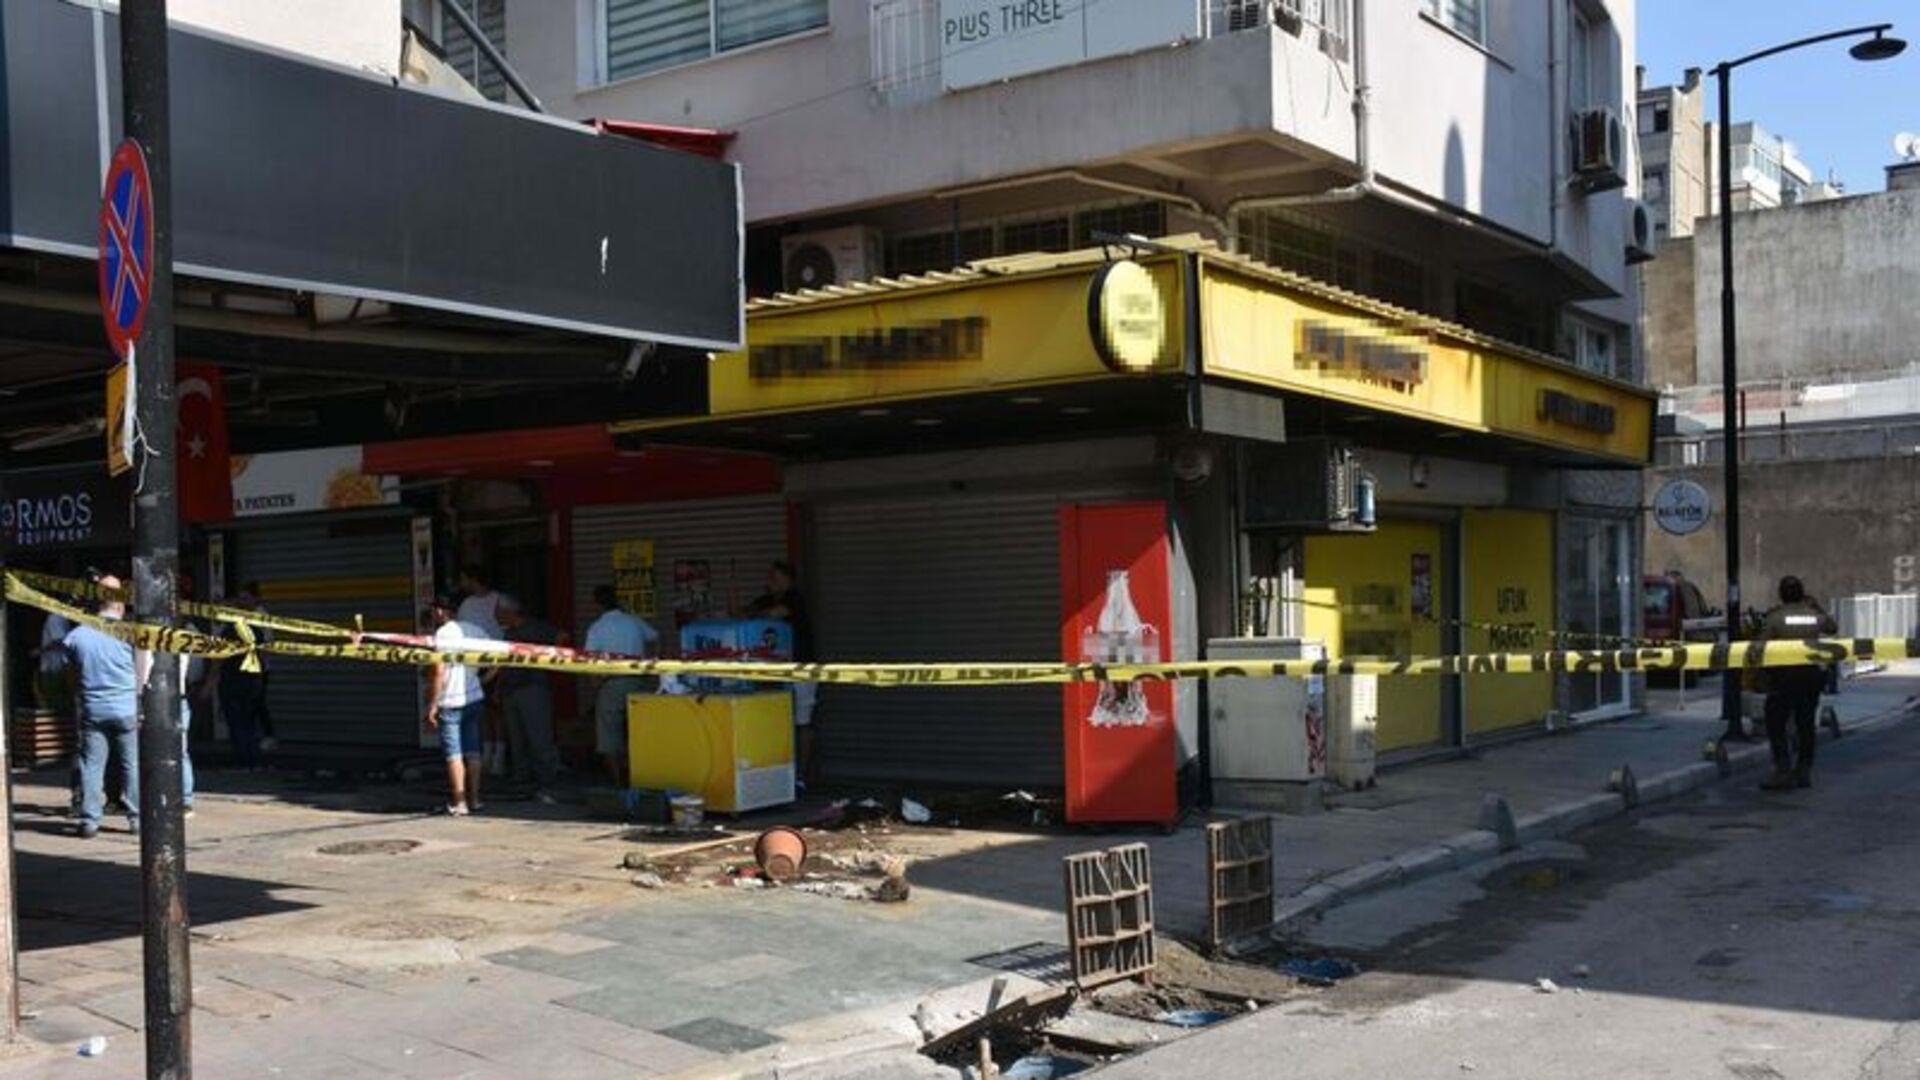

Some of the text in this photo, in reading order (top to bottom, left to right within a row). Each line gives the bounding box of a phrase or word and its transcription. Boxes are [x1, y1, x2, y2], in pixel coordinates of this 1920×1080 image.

[945, 0, 1064, 45] PLUS THREE
[245, 493, 296, 511] PATATES
